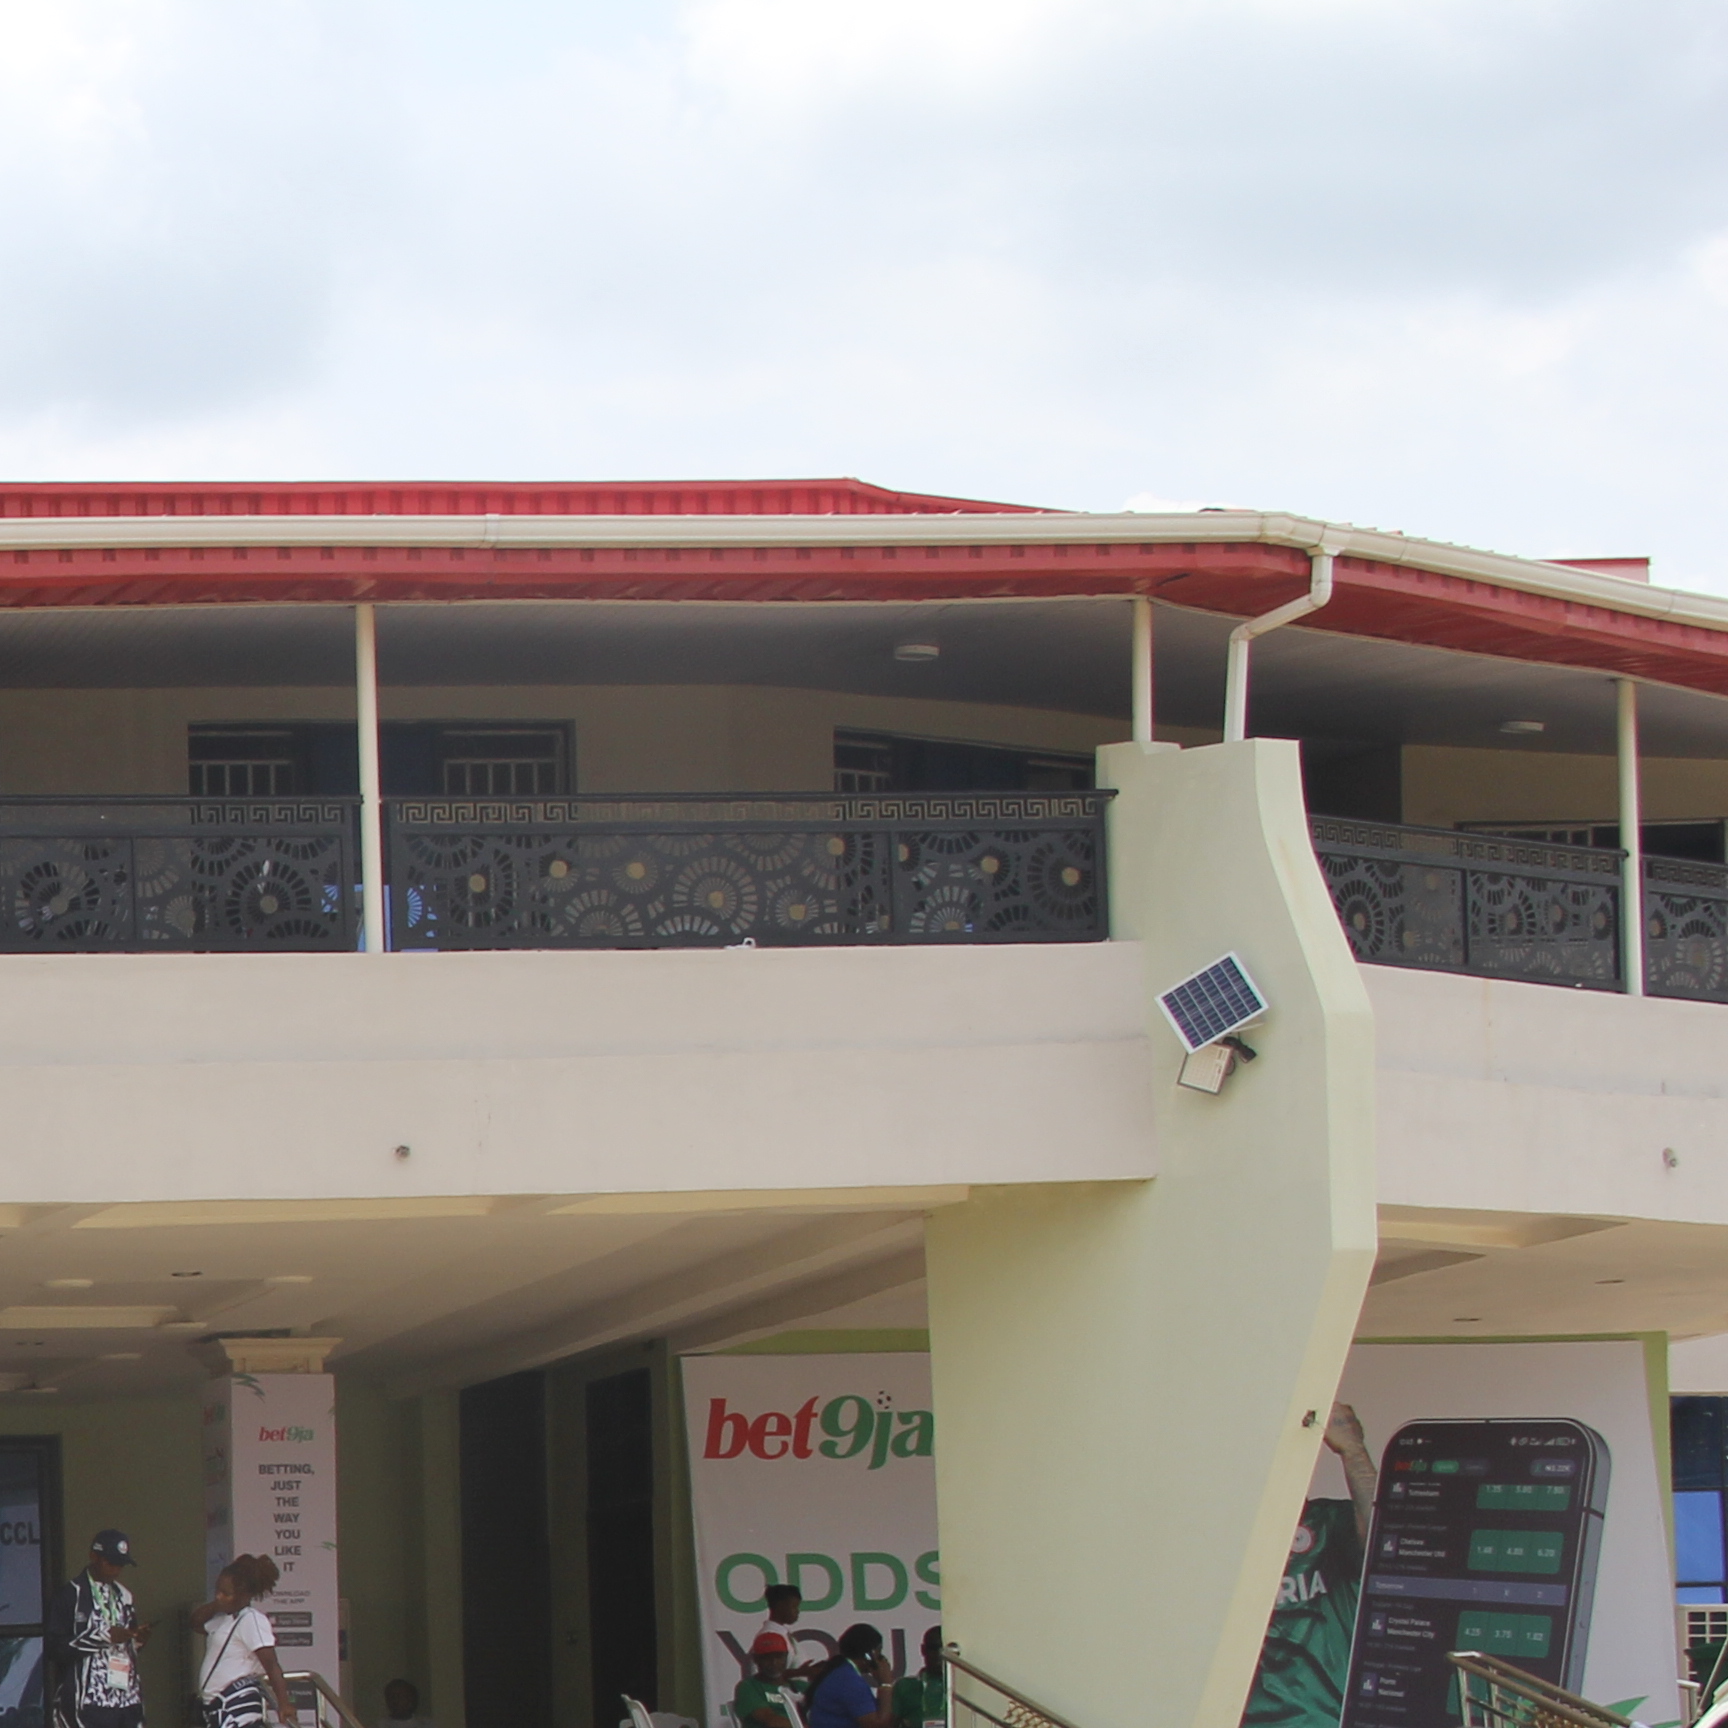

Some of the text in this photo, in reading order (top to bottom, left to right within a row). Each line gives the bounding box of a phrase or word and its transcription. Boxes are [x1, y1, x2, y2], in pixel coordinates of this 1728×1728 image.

[258, 1426, 314, 1442] bet9ja
[703, 1391, 934, 1470] bet9ja
[258, 1463, 315, 1475] BETTING,
[270, 1480, 302, 1491] JUST
[275, 1497, 299, 1507] THE
[273, 1513, 300, 1523] WAY
[275, 1529, 301, 1540] YOU
[274, 1545, 302, 1556] LIKE
[283, 1562, 295, 1572] IT
[715, 1549, 941, 1613] ODDS
